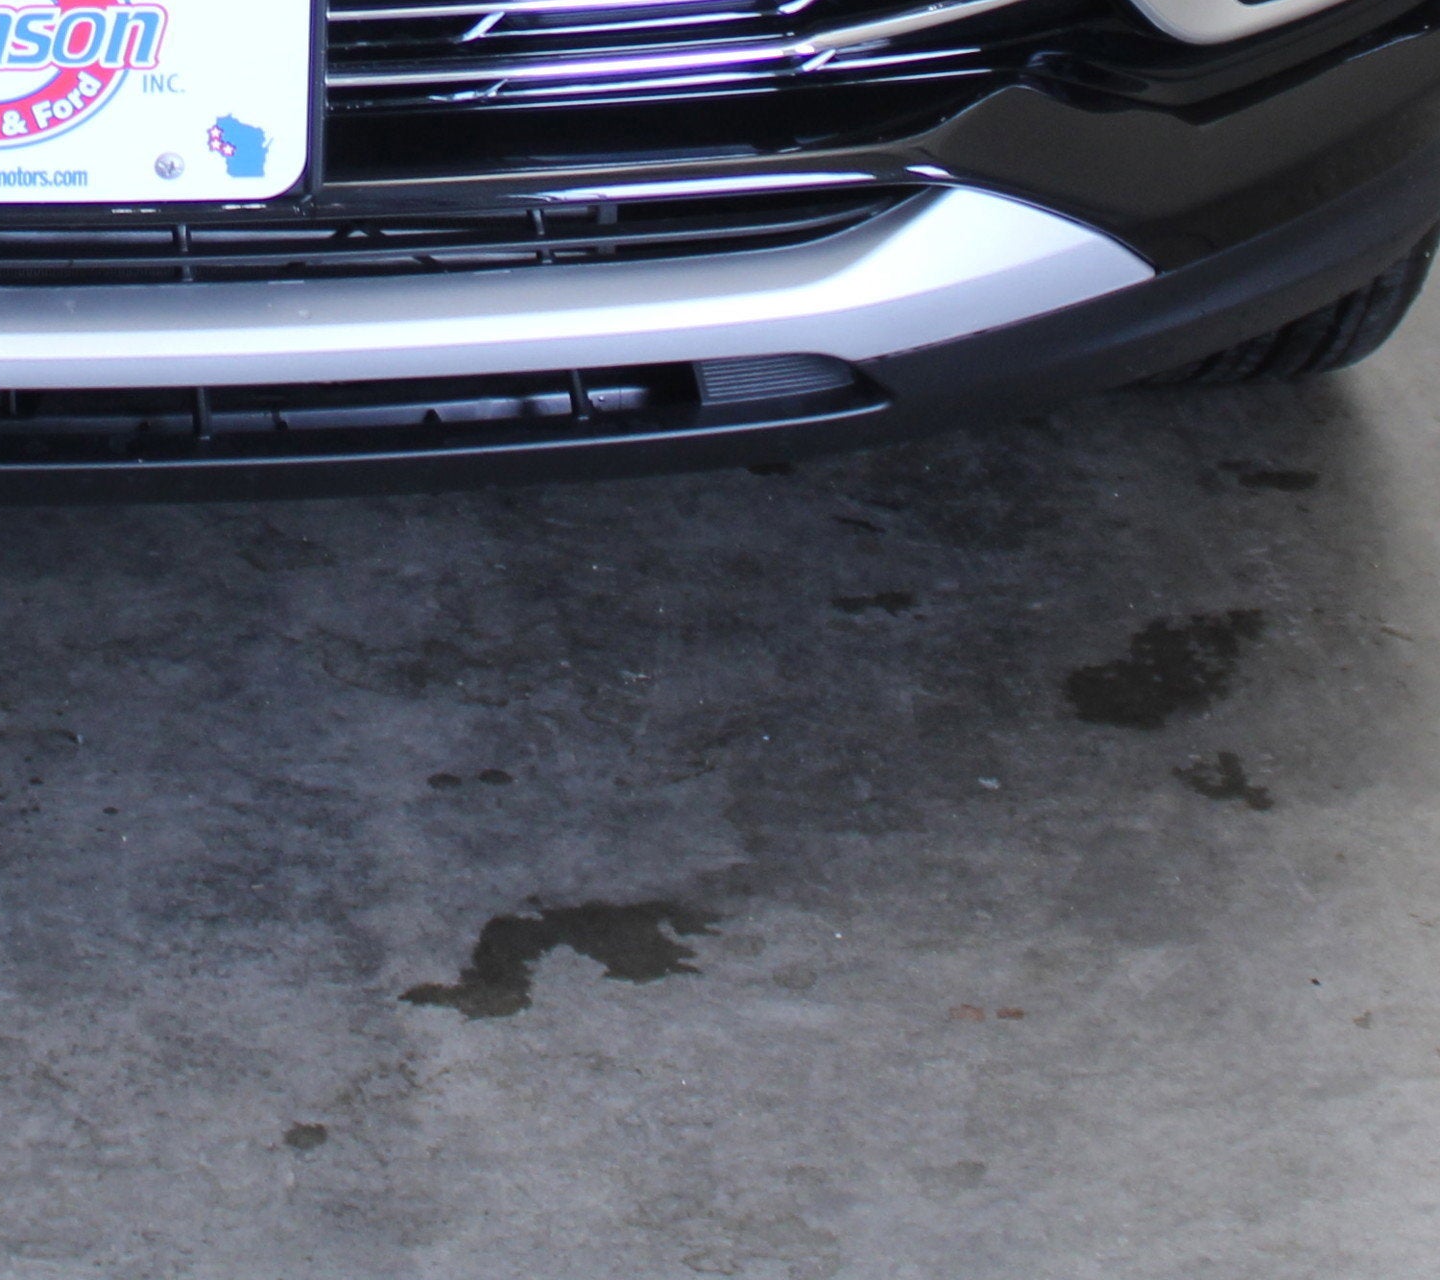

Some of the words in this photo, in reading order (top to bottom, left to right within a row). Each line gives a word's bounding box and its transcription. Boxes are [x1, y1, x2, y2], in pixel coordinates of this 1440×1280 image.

[0, 109, 29, 137] &
[30, 71, 103, 130] Ford
[141, 73, 187, 94] INC.
